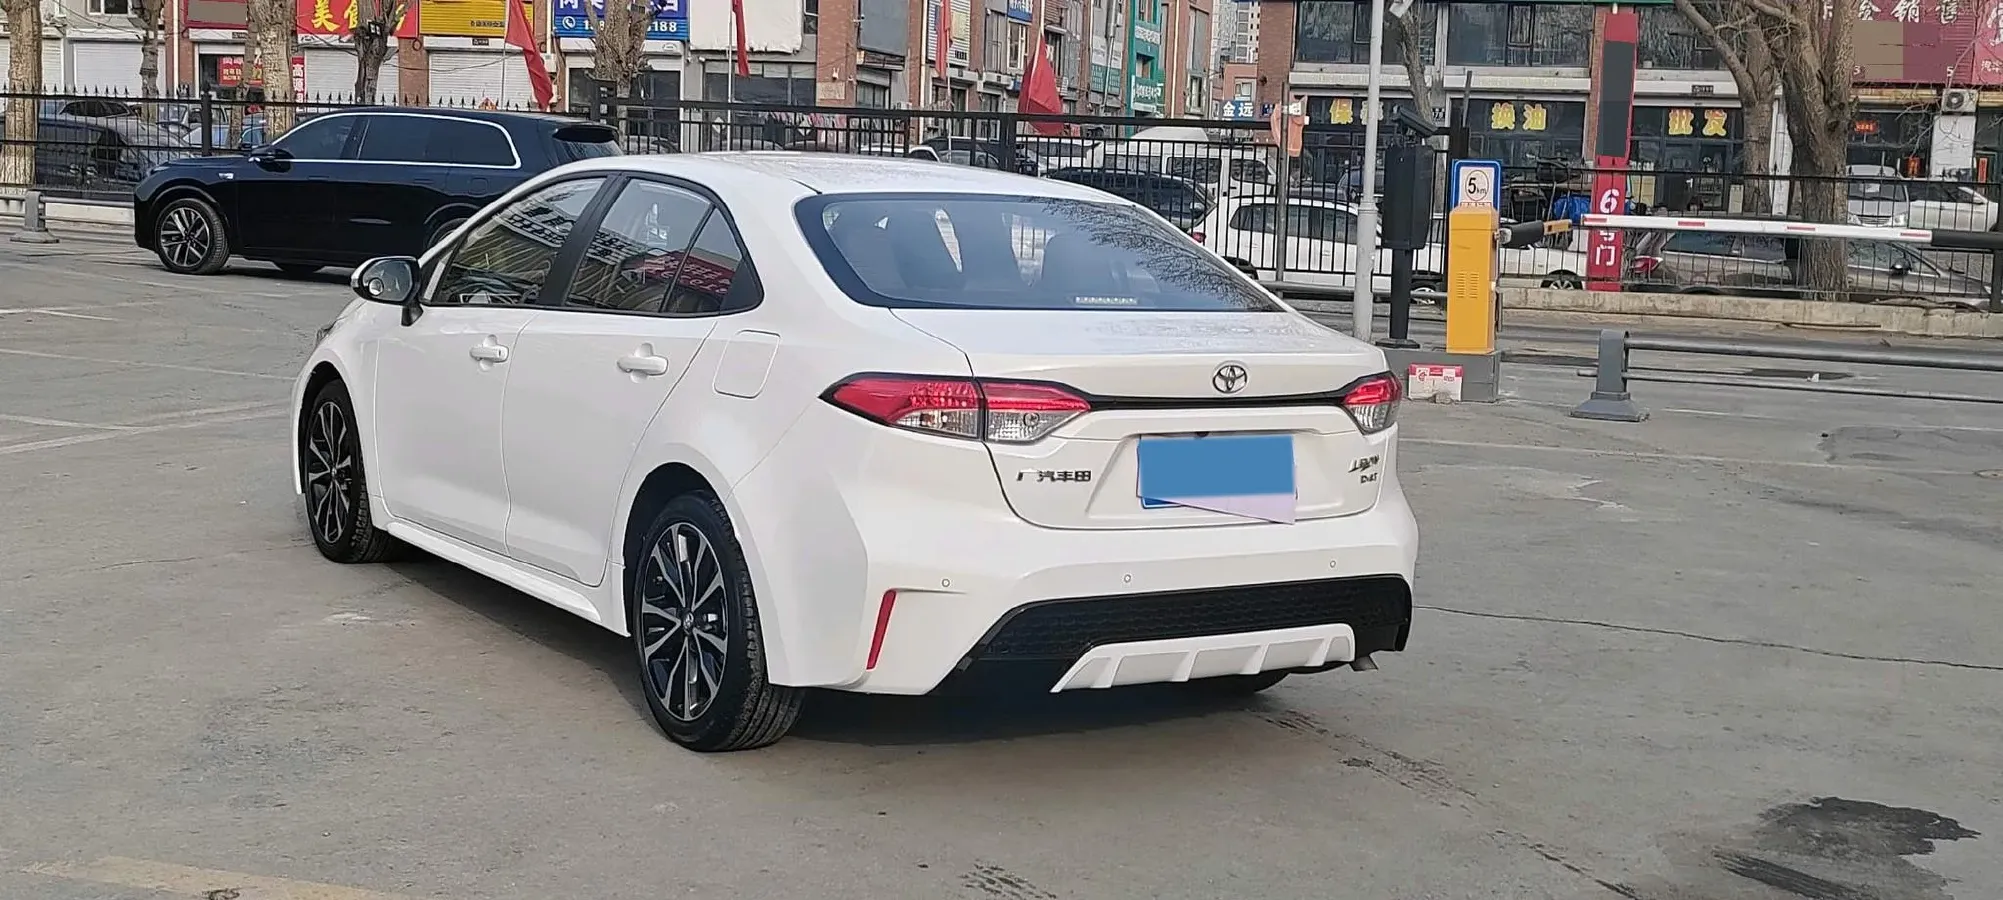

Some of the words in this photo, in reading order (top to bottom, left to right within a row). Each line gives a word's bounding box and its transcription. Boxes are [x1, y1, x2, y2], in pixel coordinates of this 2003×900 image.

[1222, 101, 1253, 117] 金远
[1491, 102, 1546, 130] 换油
[1668, 108, 1727, 136] 批发
[1016, 469, 1091, 482] 广汽丰田
